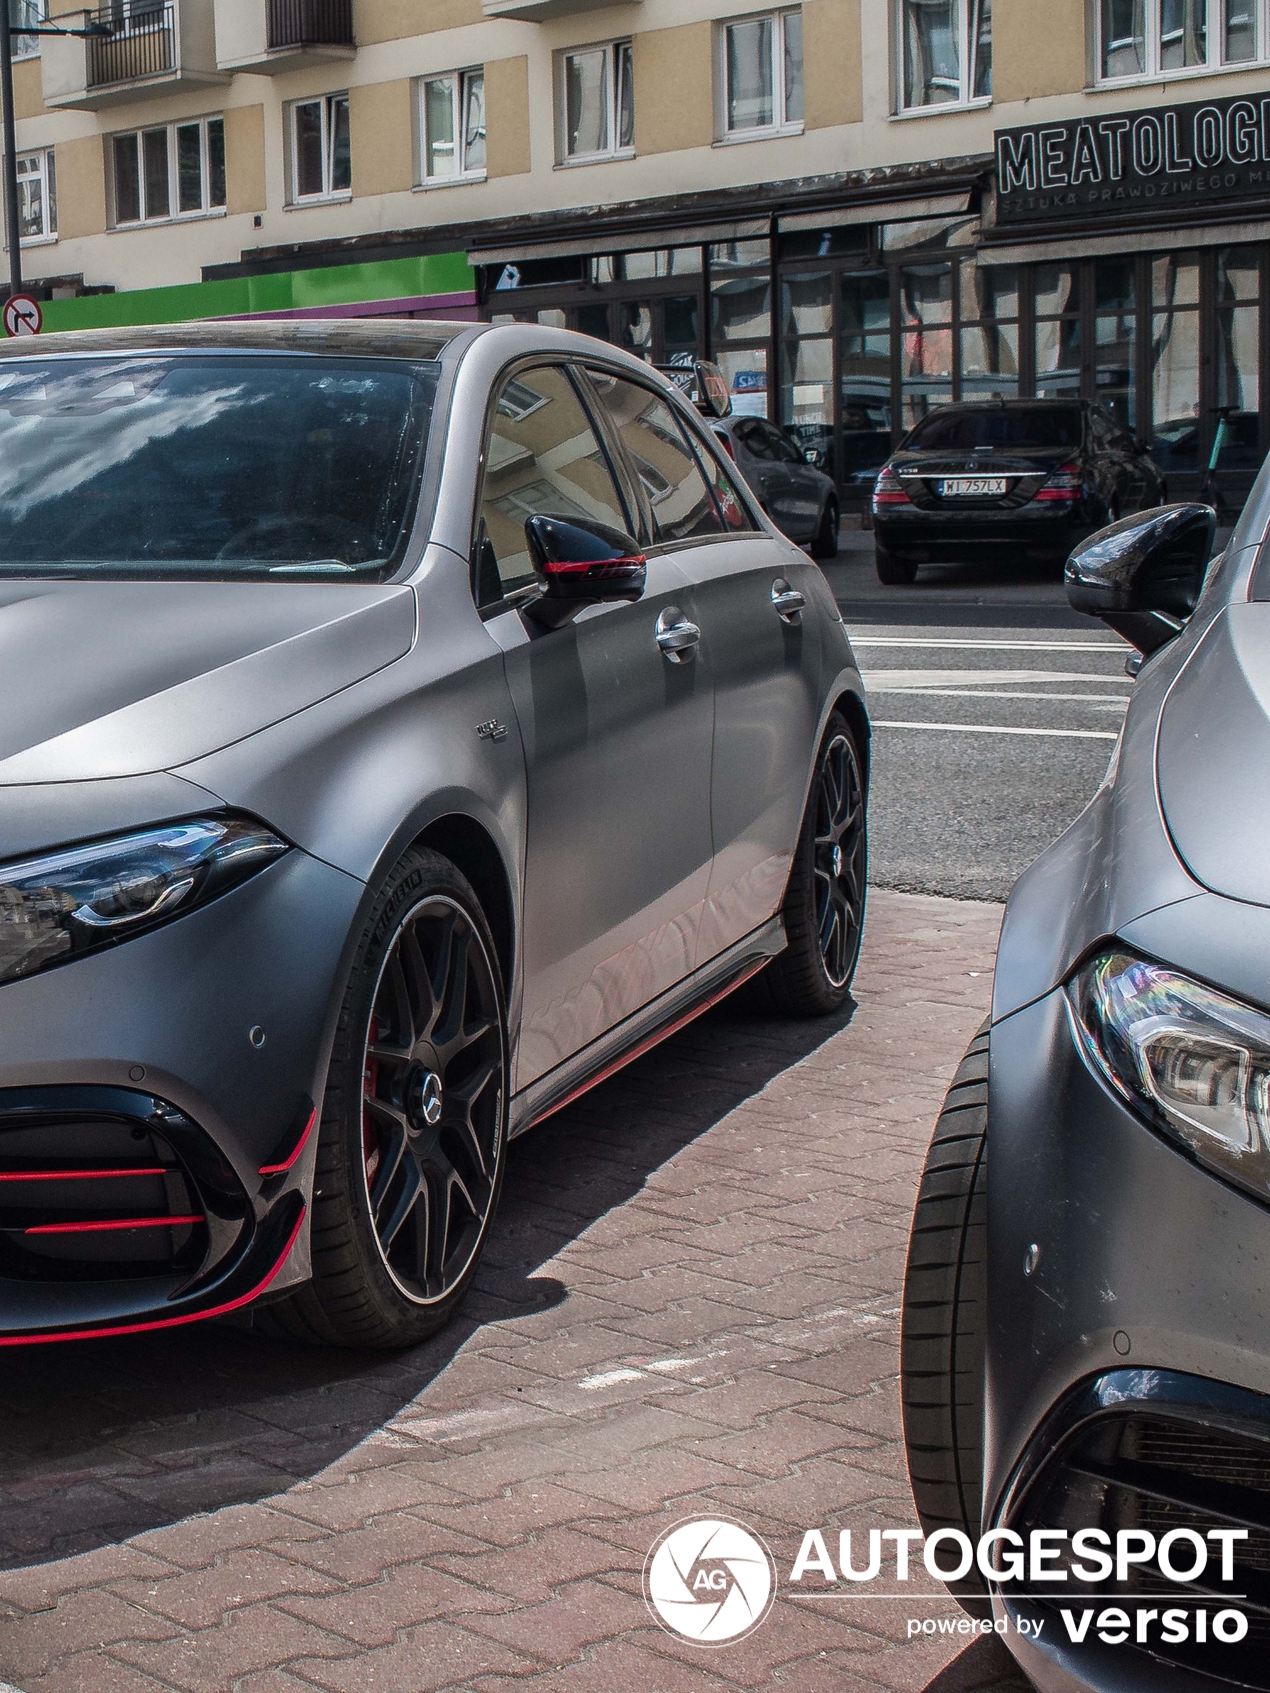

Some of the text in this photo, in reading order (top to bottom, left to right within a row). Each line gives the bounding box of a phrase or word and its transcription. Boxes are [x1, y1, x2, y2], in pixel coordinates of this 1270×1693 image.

[1002, 192, 1077, 214] SZTUKA
[1088, 172, 1237, 202] PRAWDZIWEGO
[946, 480, 1003, 492] WI 757LX
[375, 869, 422, 941] MICHELIN
